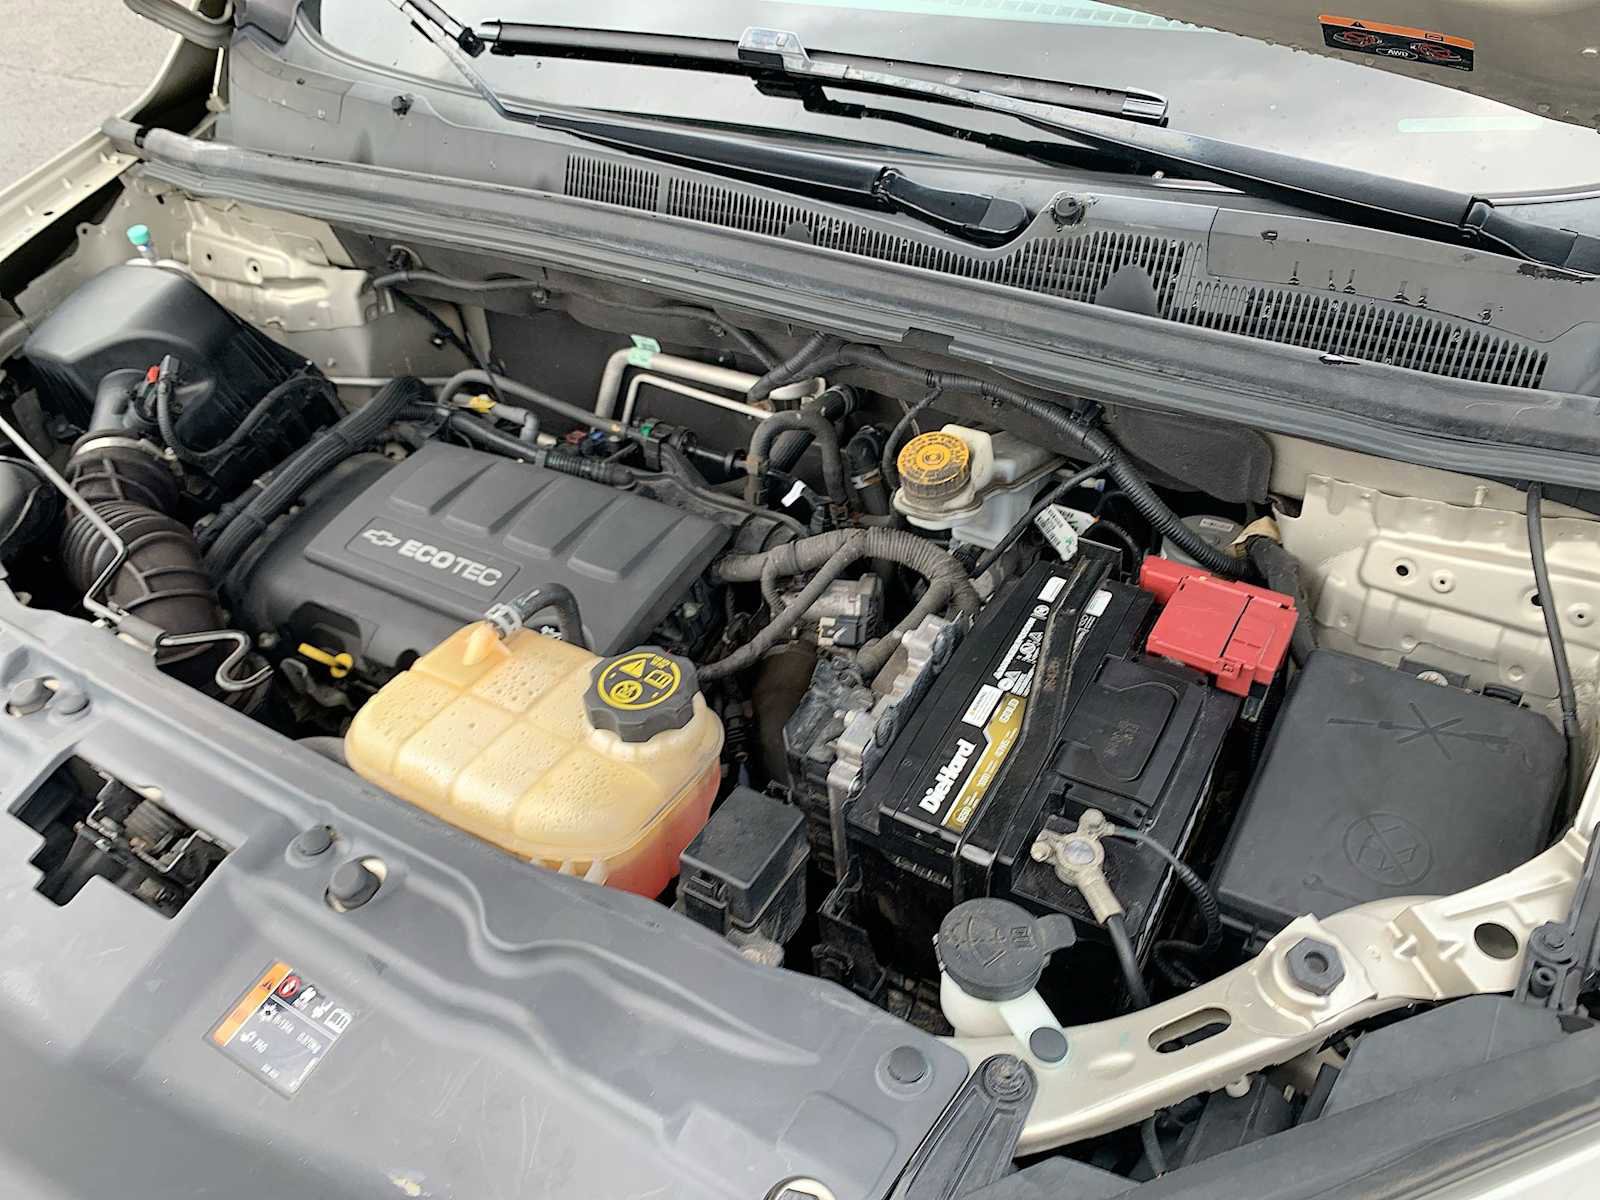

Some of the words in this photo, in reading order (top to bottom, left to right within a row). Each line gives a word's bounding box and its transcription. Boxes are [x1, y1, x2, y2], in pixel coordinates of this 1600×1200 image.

[1387, 49, 1409, 57] AWD
[397, 538, 503, 587] ECOTEC
[918, 737, 977, 815] DieHard
